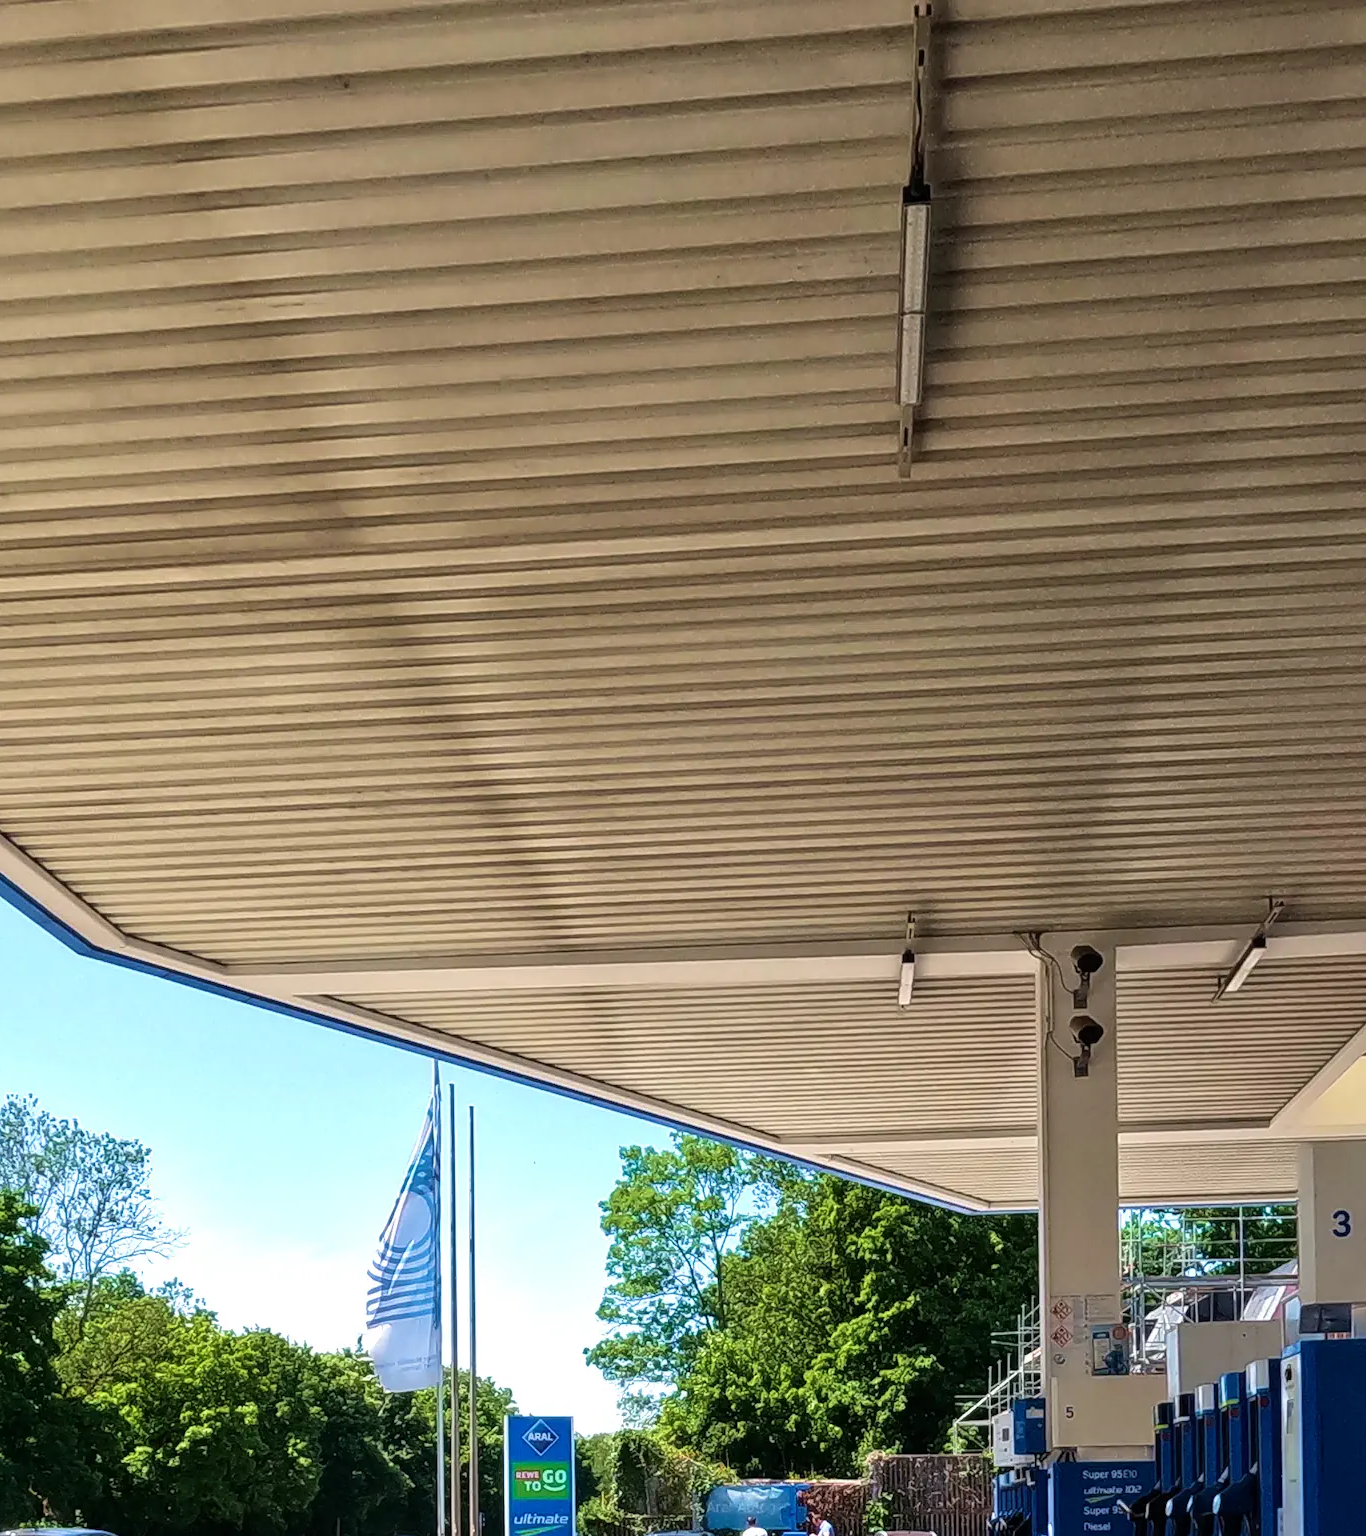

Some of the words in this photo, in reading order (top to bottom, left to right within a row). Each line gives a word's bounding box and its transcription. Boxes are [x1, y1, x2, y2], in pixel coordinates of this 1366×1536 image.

[1332, 1210, 1352, 1238] 3
[1065, 1406, 1075, 1419] 5
[527, 1432, 554, 1441] ARAL
[515, 1471, 540, 1479] REWE
[1082, 1469, 1109, 1480] Super
[524, 1481, 542, 1491] TO
[542, 1469, 567, 1483] GO
[1083, 1486, 1123, 1495] ultimate
[1125, 1485, 1142, 1494] 102
[1083, 1506, 1110, 1516] Super
[513, 1513, 569, 1524] ultimate
[1084, 1522, 1111, 1531] Diesel
